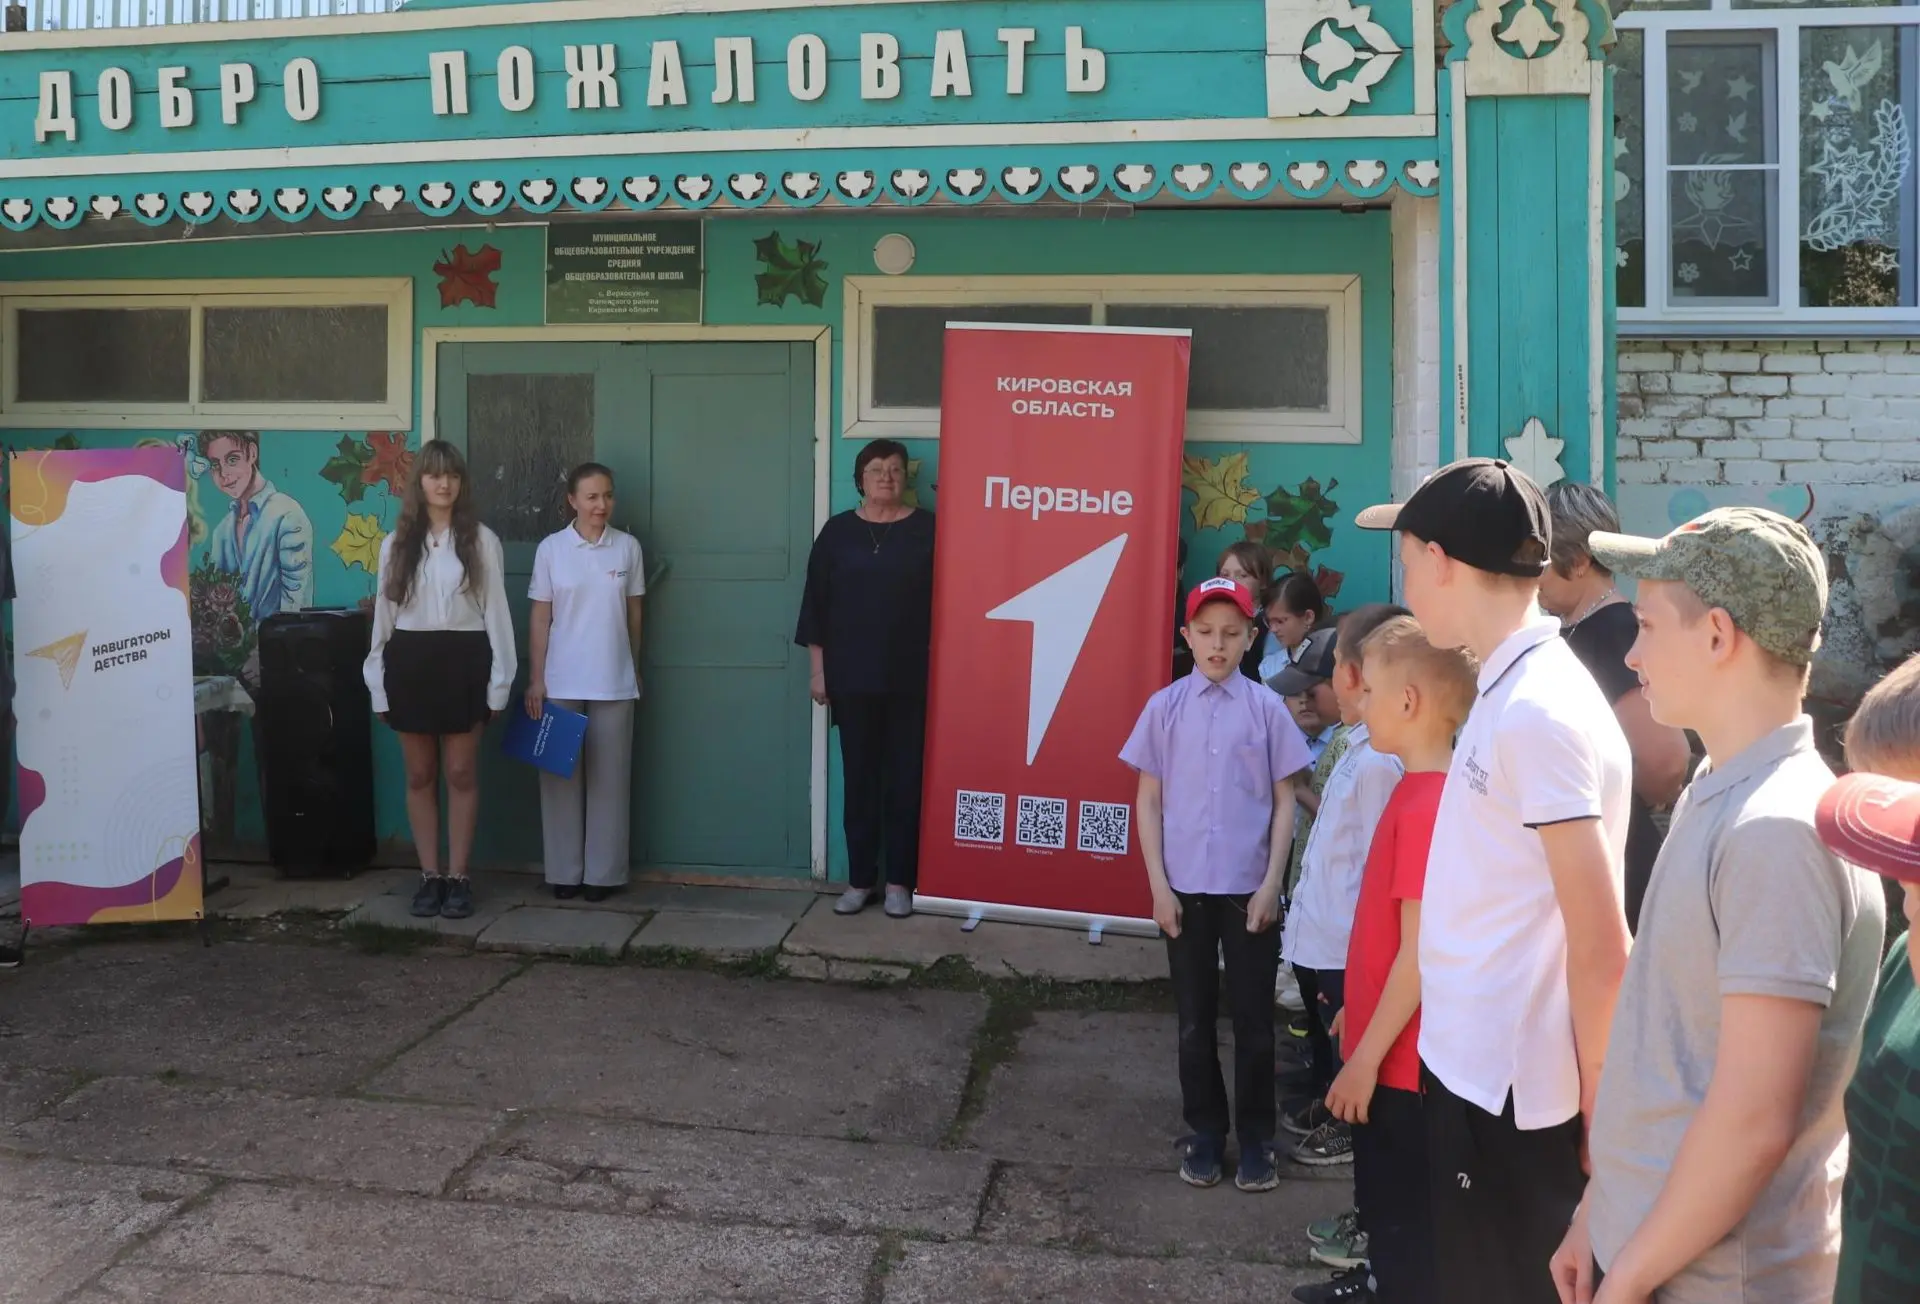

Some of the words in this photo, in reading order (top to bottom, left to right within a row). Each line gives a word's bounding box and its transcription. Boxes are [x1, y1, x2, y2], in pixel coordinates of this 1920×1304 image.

[35, 57, 321, 142] ДОБРО
[429, 26, 1106, 115] ПОЖАЛОВАТЬ
[592, 233, 657, 242] МУНИЦИПАЛЬНОЕ
[554, 246, 645, 256] ОБЩЕОБРАЗОВАТЕЛЬНОЕ
[646, 246, 696, 255] УЧРЕЖДЕНИЕ
[607, 259, 642, 268] СРЕДНЯЯ
[565, 272, 656, 281] ОБЩЕОБРАЗОВАТЕЛЬНАЯ
[657, 272, 684, 280] ШКОЛА
[997, 377, 1132, 396] КИРОВСКАЯ
[1012, 399, 1115, 418] ОБЛАСТЬ
[984, 476, 1134, 520] Первые
[92, 629, 171, 656] НАВИГАТОРЫ
[94, 650, 148, 672] ДЕТСТВА
